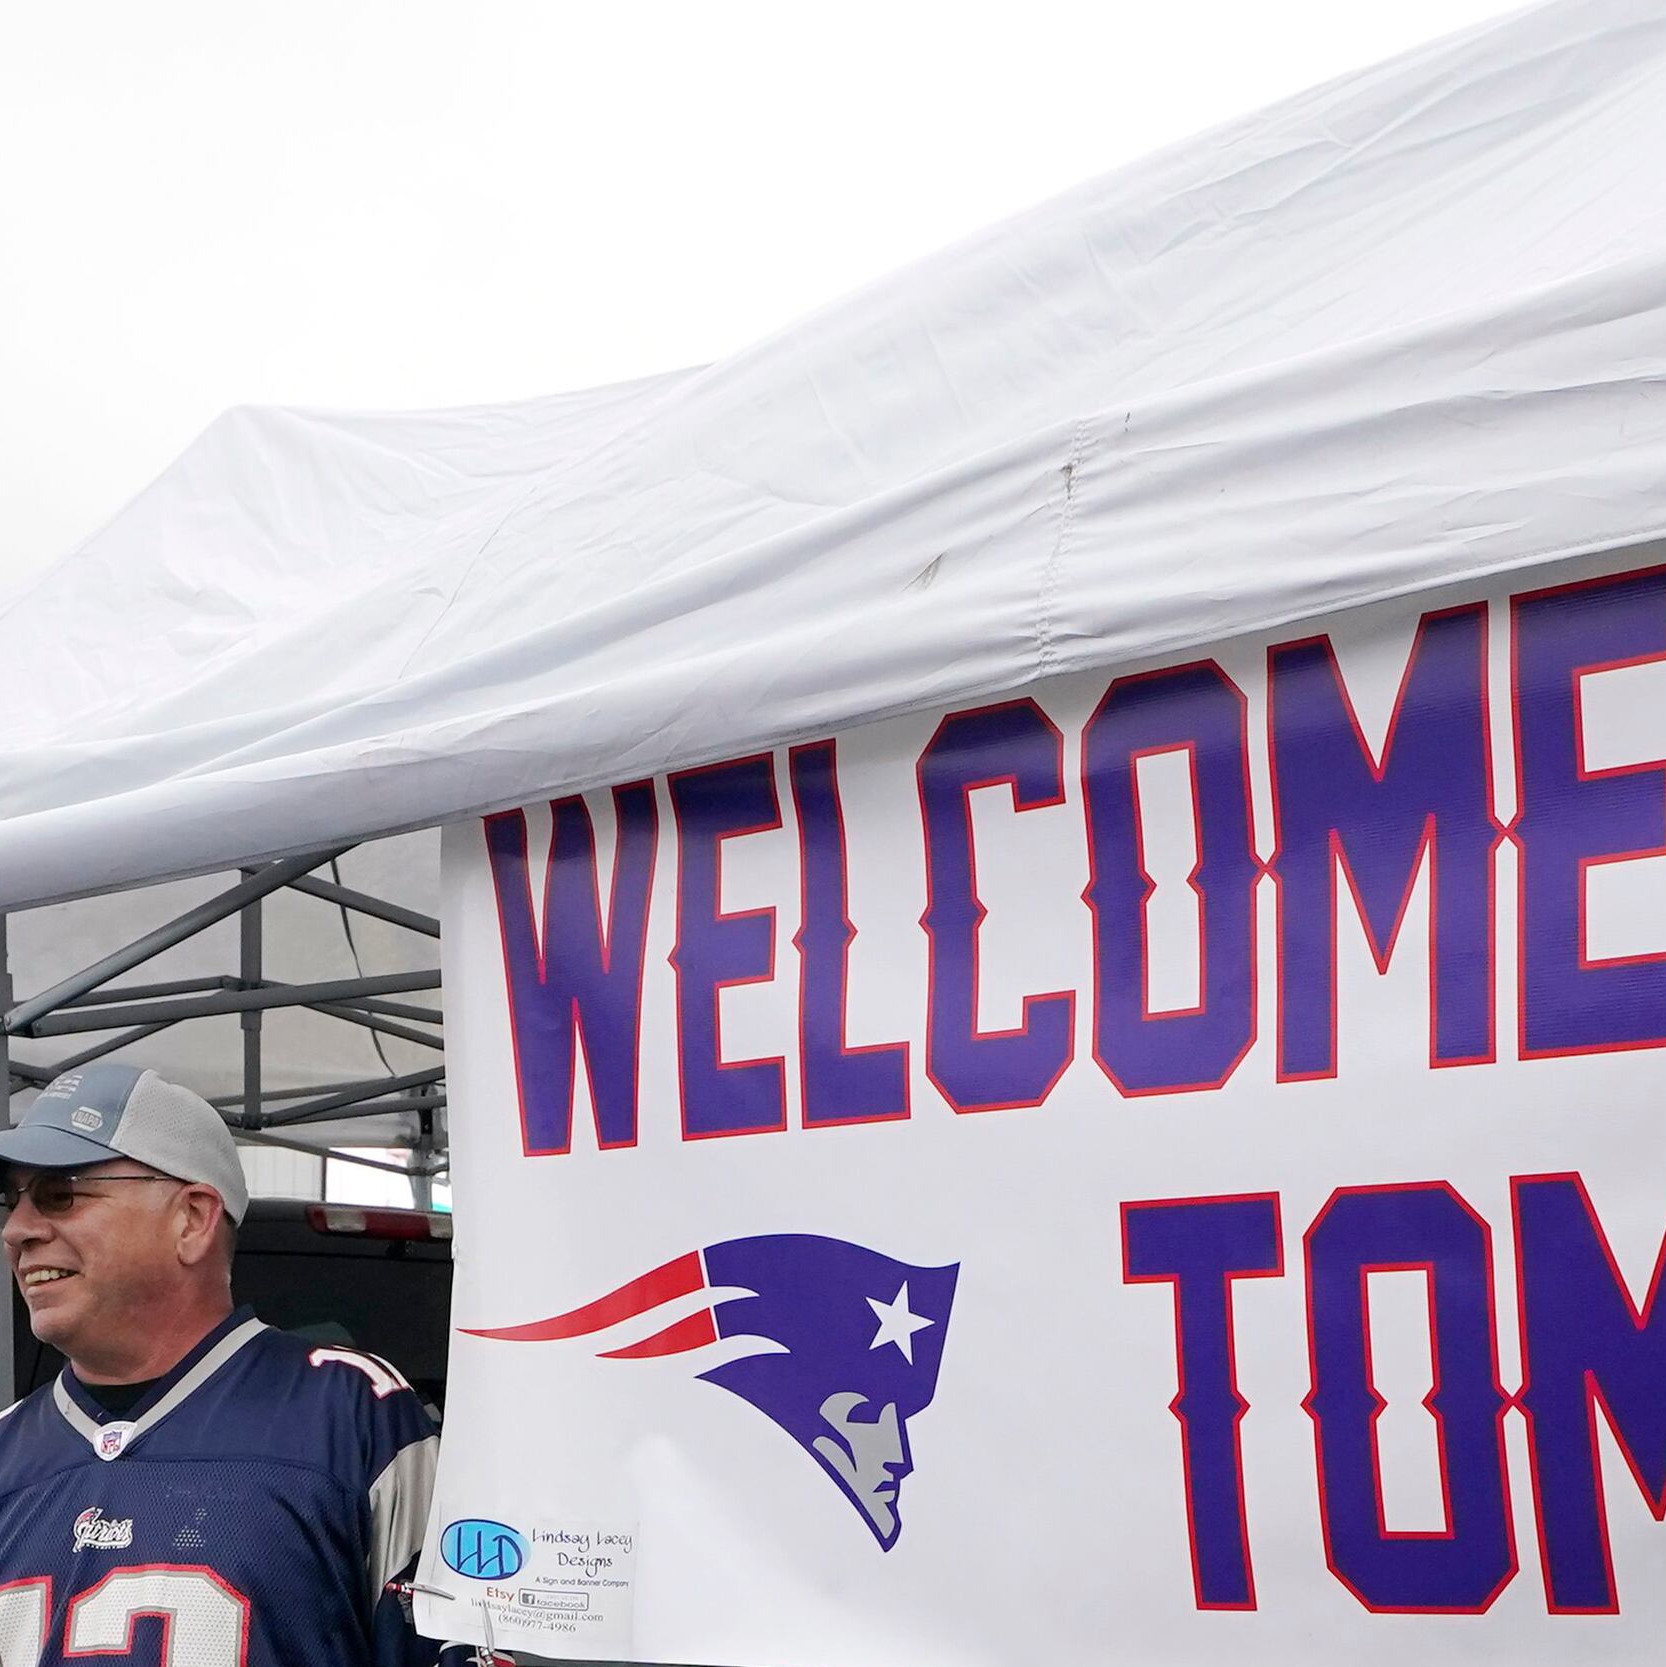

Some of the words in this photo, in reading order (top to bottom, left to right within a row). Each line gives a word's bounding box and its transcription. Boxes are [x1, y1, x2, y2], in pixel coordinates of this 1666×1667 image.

[532, 1528, 590, 1553] Lindsay
[596, 1530, 633, 1554] Lacey
[557, 1552, 613, 1578] Designs
[542, 1577, 559, 1586] Sign
[560, 1578, 576, 1586] and
[577, 1579, 601, 1587] Banner
[486, 1586, 515, 1602] Etsy
[536, 1599, 586, 1609] facebook
